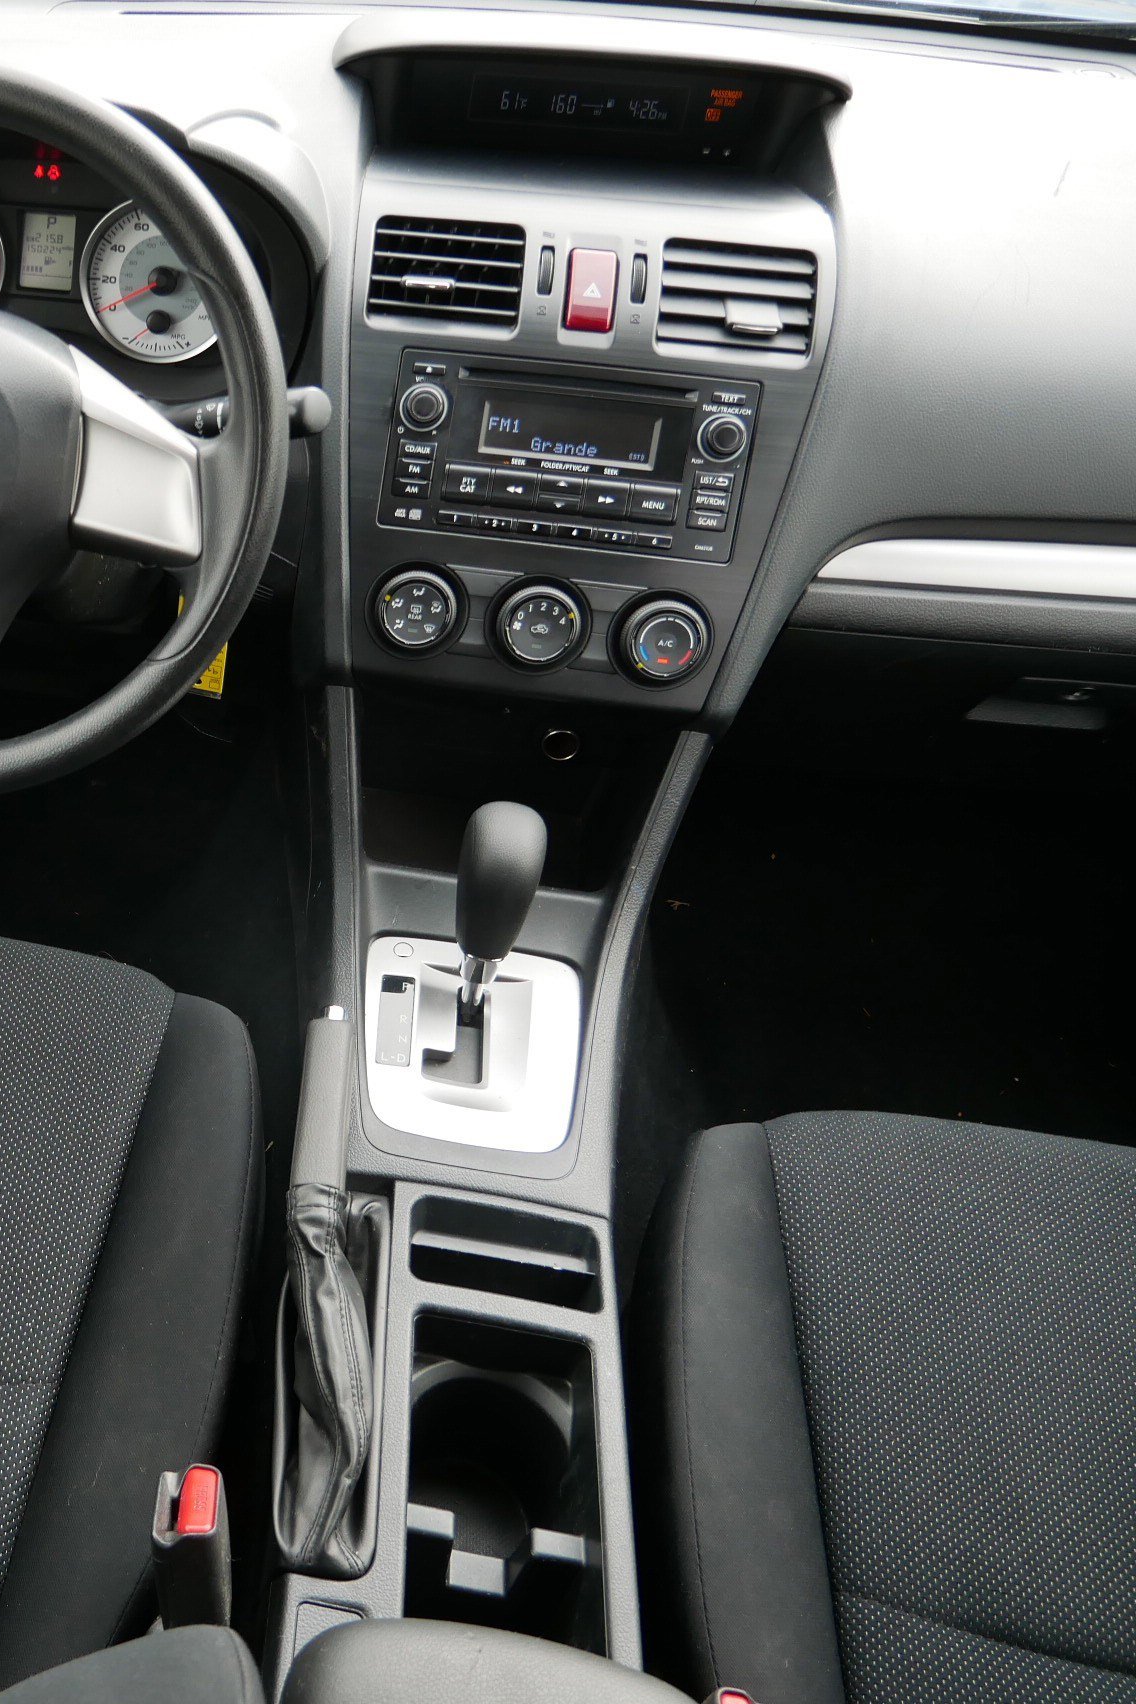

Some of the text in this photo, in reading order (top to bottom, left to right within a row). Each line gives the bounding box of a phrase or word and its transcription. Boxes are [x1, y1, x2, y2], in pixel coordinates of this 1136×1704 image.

[550, 94, 577, 114] 160
[47, 216, 57, 229] P
[134, 223, 150, 231] 60
[110, 244, 126, 253] 40
[102, 276, 117, 284] 20
[721, 394, 738, 403] TEXT
[488, 415, 521, 434] FM1
[404, 444, 431, 454] CD/AUX
[530, 436, 599, 458] Grande
[510, 457, 526, 466] SEEK
[603, 467, 619, 476] SEEK
[462, 476, 477, 485] PTY
[405, 485, 418, 494] AM
[459, 484, 477, 494] CAT
[641, 500, 666, 511] MENU
[697, 517, 717, 527] SCAN
[528, 604, 533, 613] 1
[540, 602, 547, 612] 2
[552, 606, 559, 616] 3
[407, 613, 423, 621] REAR
[517, 611, 524, 621] 0
[558, 617, 566, 626] 4
[657, 640, 674, 649] A/C
[399, 1013, 408, 1025] R
[398, 1034, 408, 1044] N
[396, 1052, 406, 1063] D
